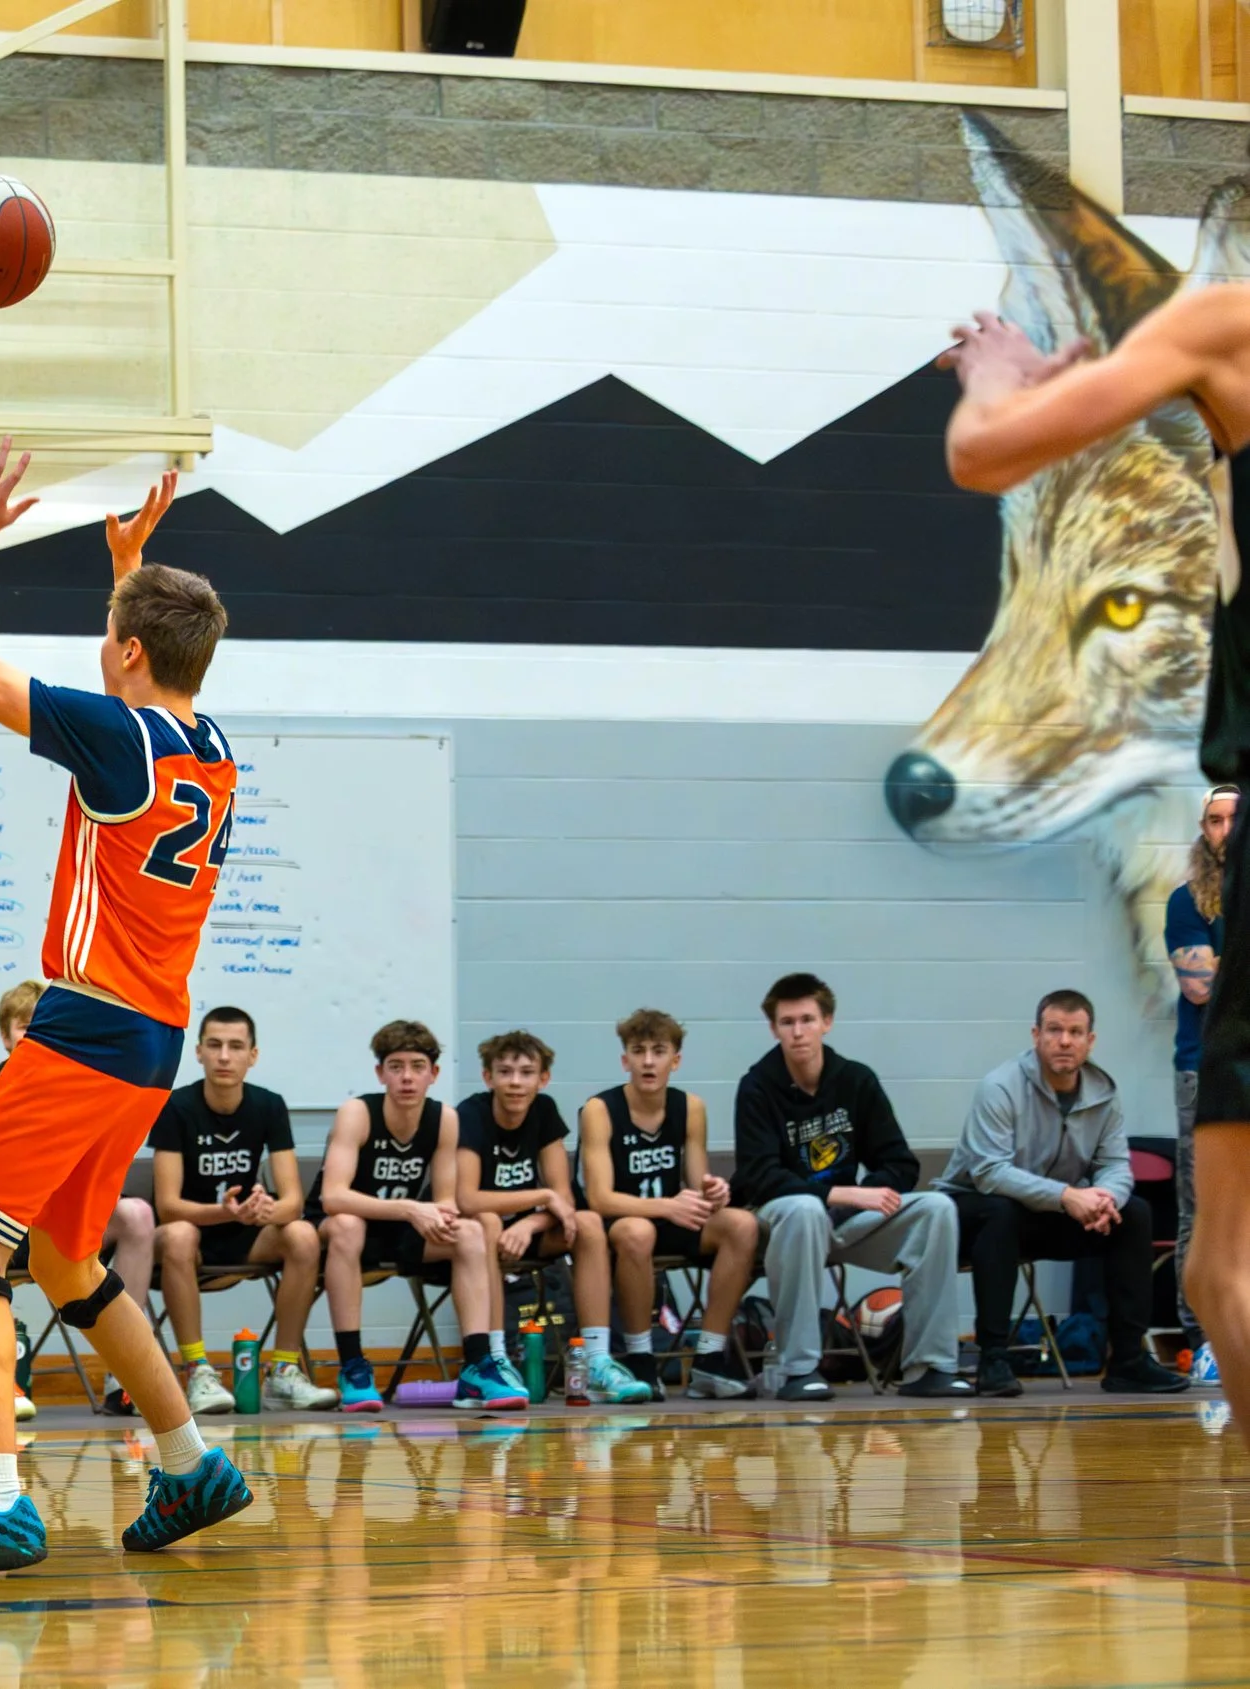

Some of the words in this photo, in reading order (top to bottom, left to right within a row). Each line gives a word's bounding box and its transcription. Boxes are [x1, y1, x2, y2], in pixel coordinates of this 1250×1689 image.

[139, 778, 236, 893] 24
[198, 1150, 251, 1176] GESS
[373, 1157, 424, 1181] GESS
[629, 1145, 676, 1174] GESS
[639, 1176, 663, 1198] 11
